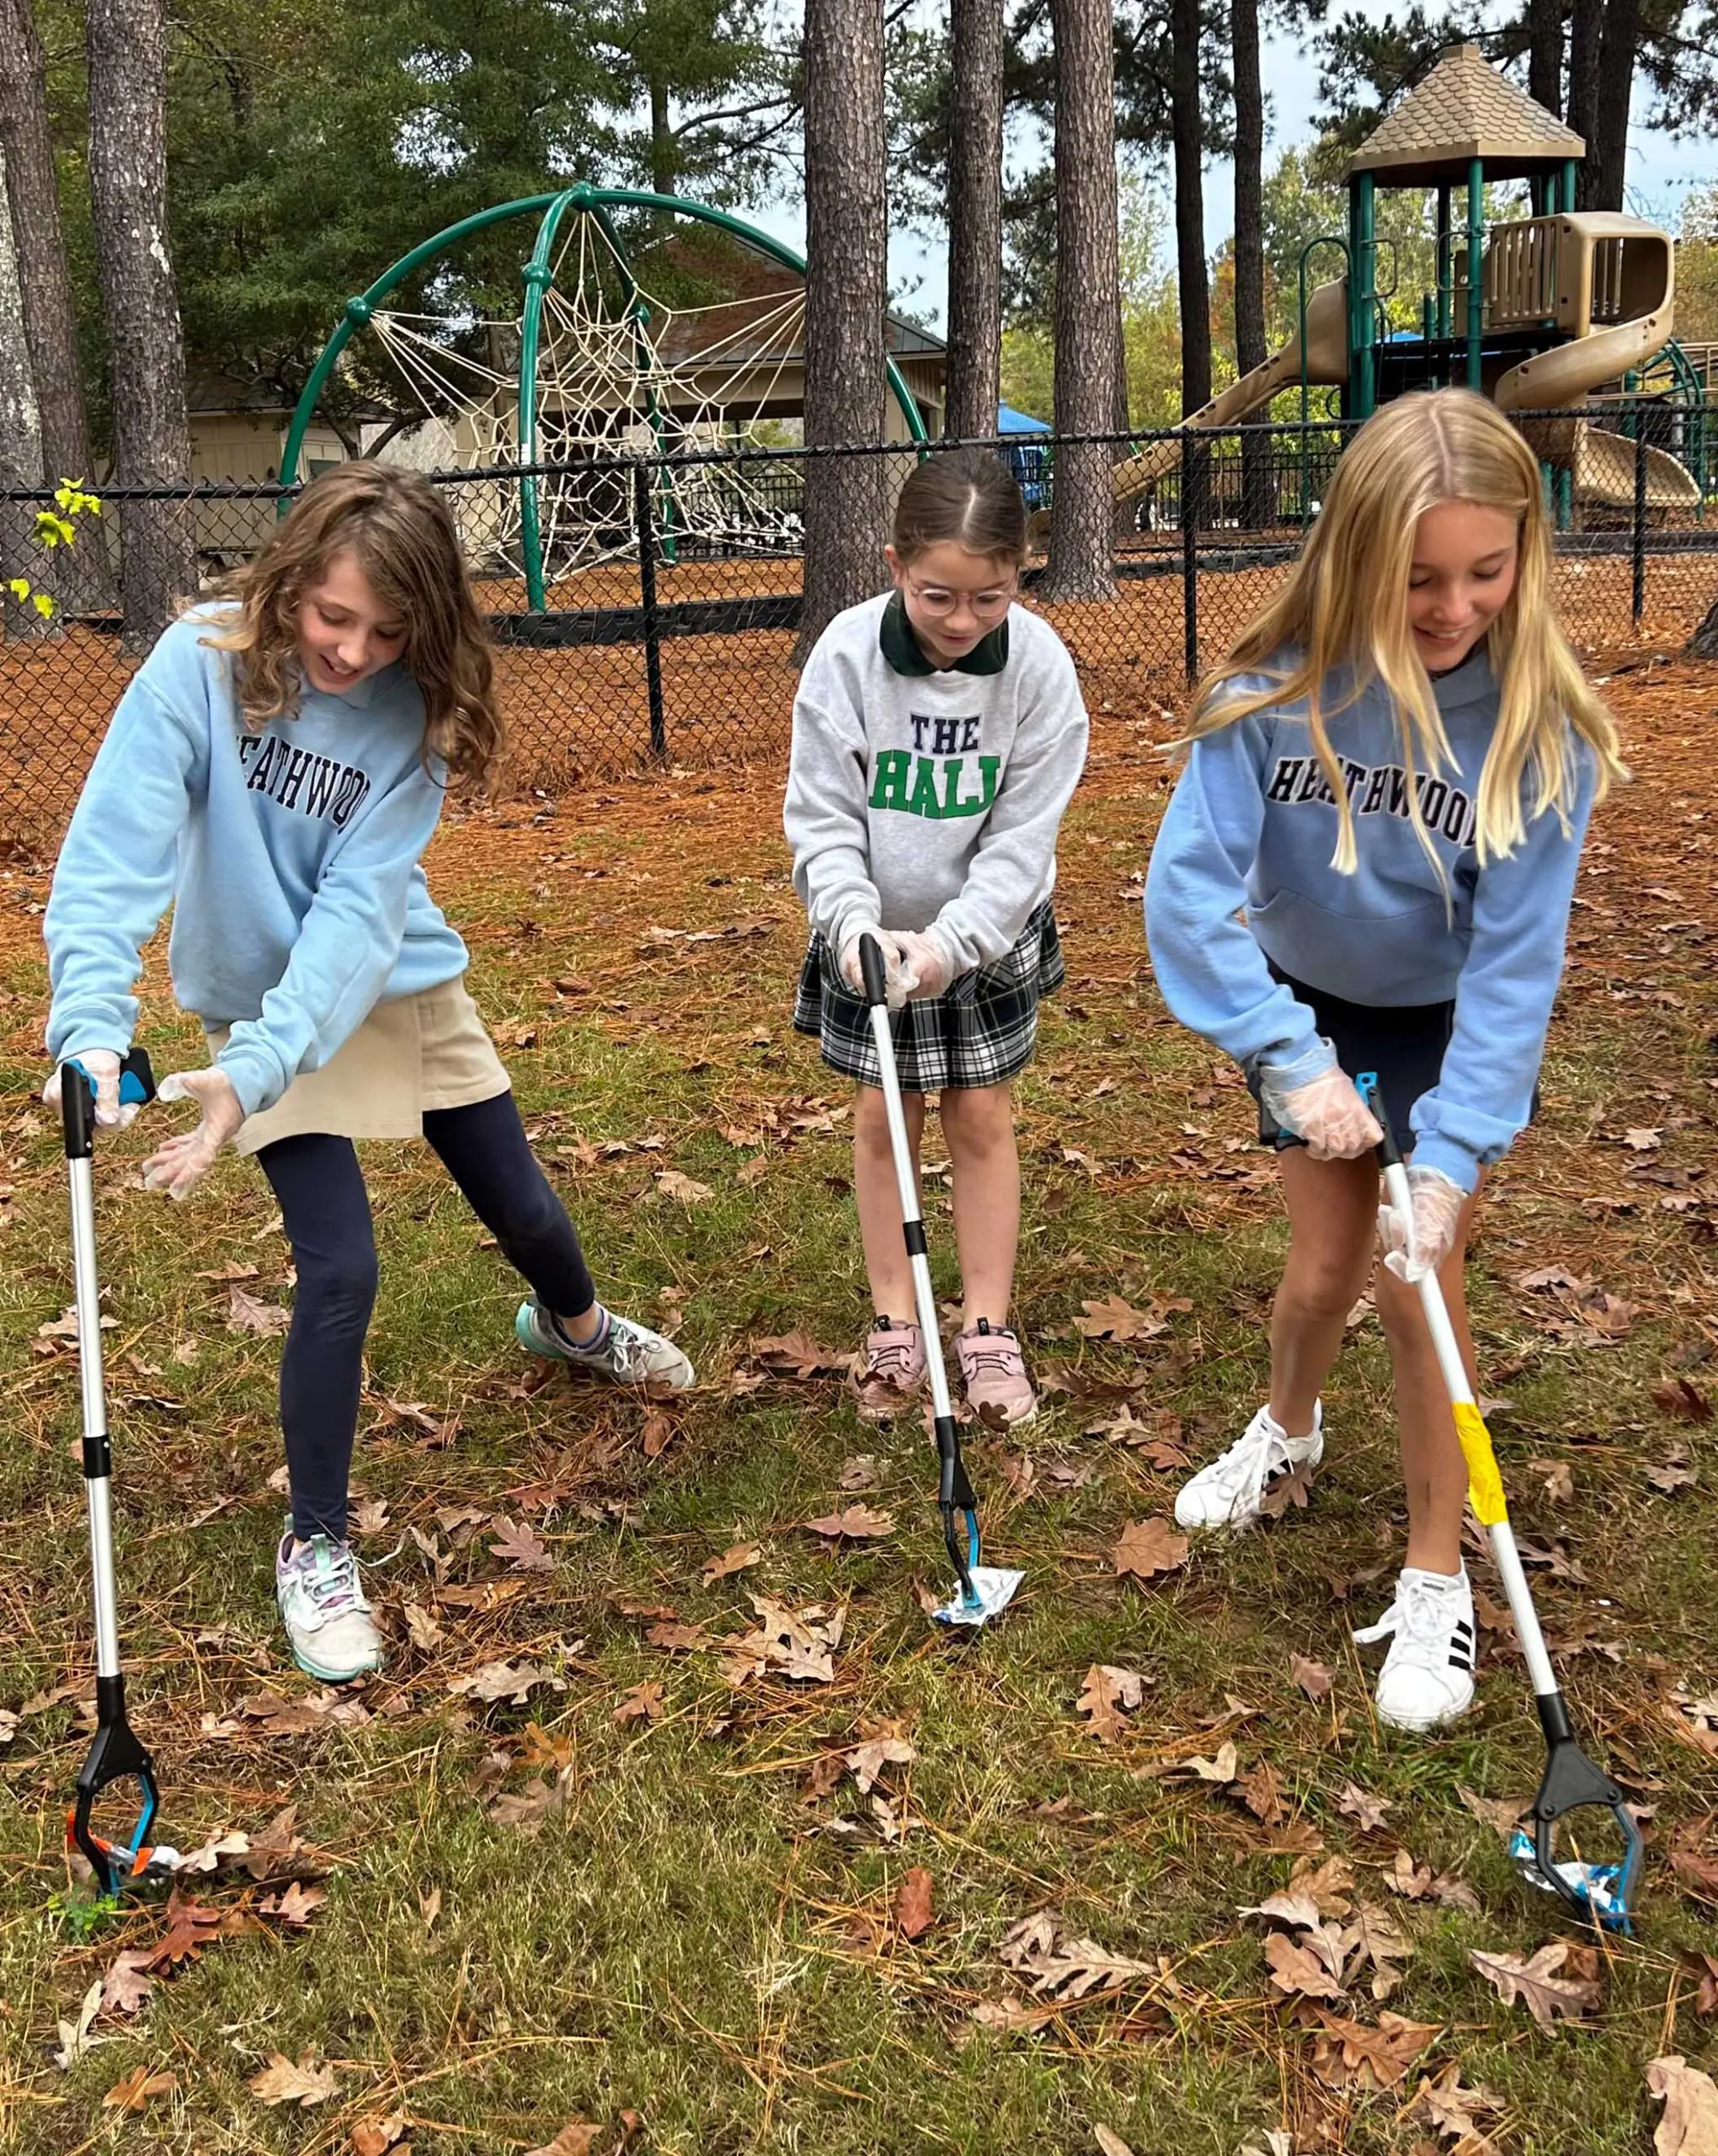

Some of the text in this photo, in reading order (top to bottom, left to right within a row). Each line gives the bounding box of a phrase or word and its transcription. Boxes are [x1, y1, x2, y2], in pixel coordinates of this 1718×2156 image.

[910, 714, 979, 754] THE
[237, 735, 371, 835] EATHWOO
[868, 750, 1000, 819] HALL
[1266, 756, 1476, 847] HETHWOO
